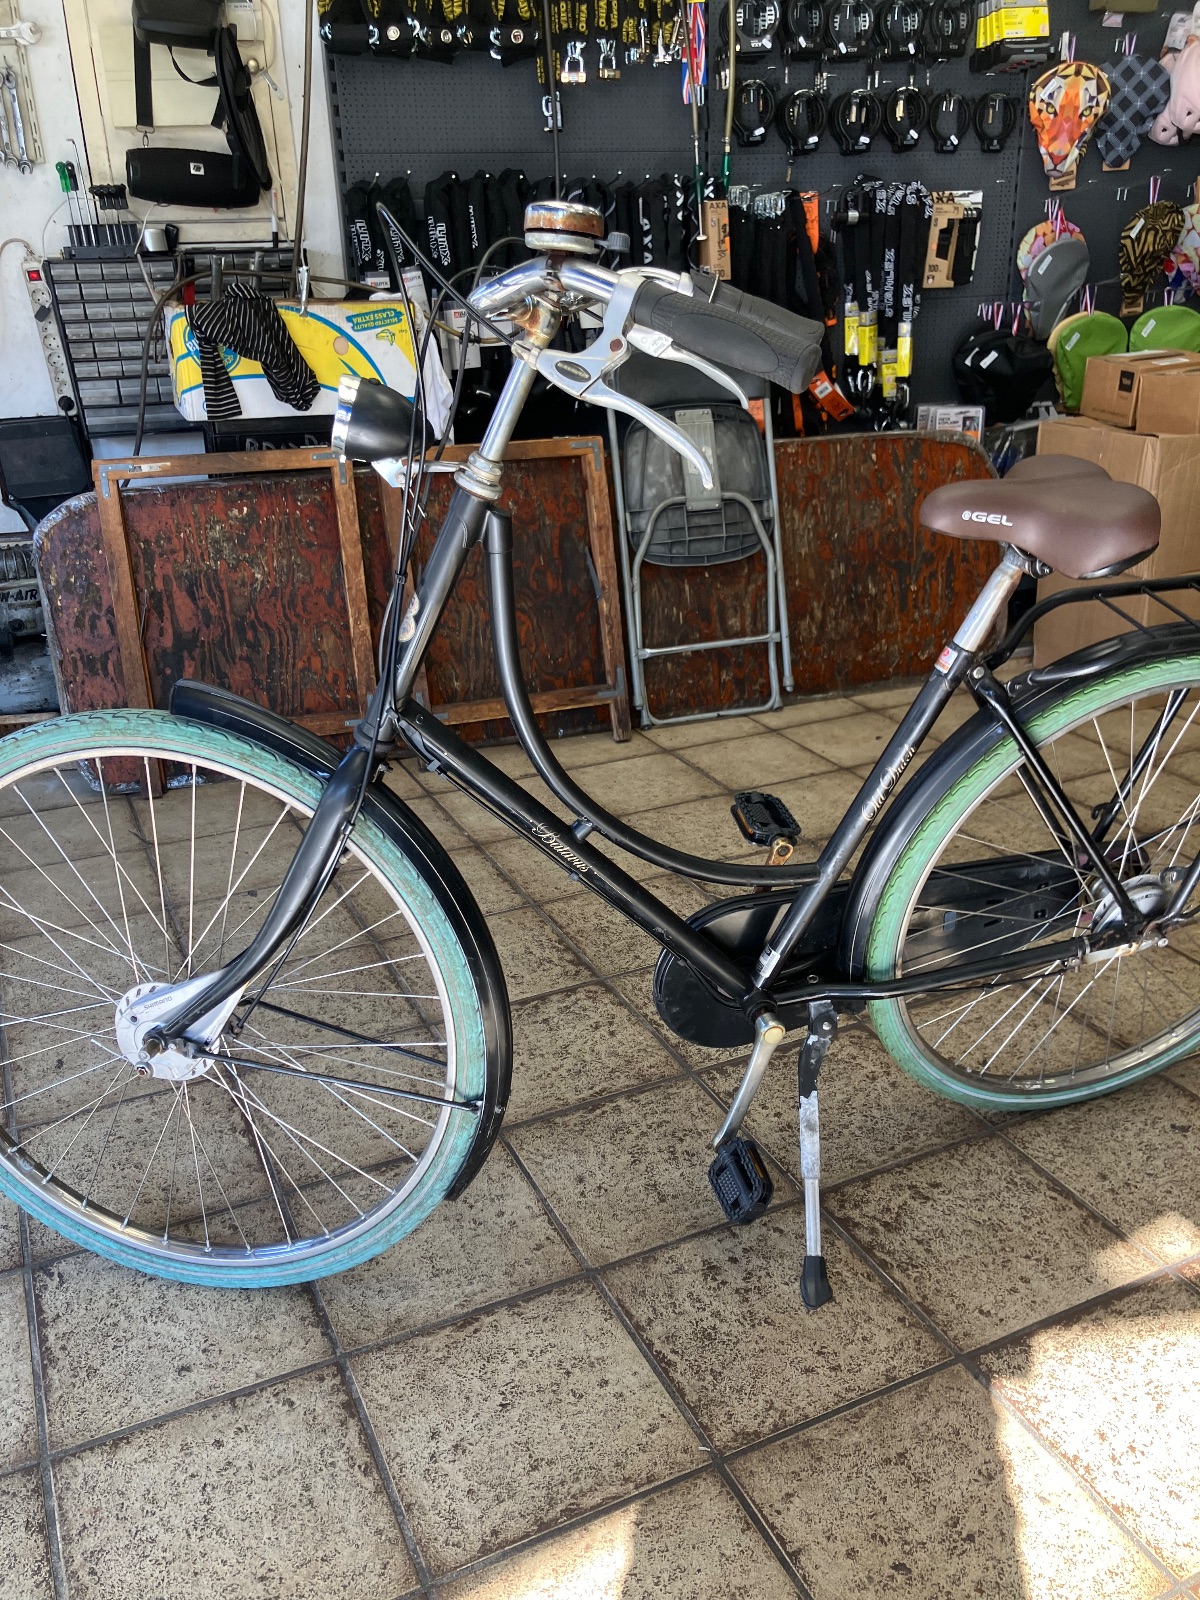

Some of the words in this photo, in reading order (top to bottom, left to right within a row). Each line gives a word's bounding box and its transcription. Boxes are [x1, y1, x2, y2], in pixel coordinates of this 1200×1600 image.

[708, 202, 727, 210] AXA
[928, 264, 939, 273] 100
[352, 314, 374, 324] EXTRA
[374, 310, 395, 320] CLASS
[354, 321, 374, 330] QUALITY
[375, 317, 398, 326] SELECTED
[971, 511, 1013, 527] GEL
[143, 995, 173, 1011] SHIMANO
